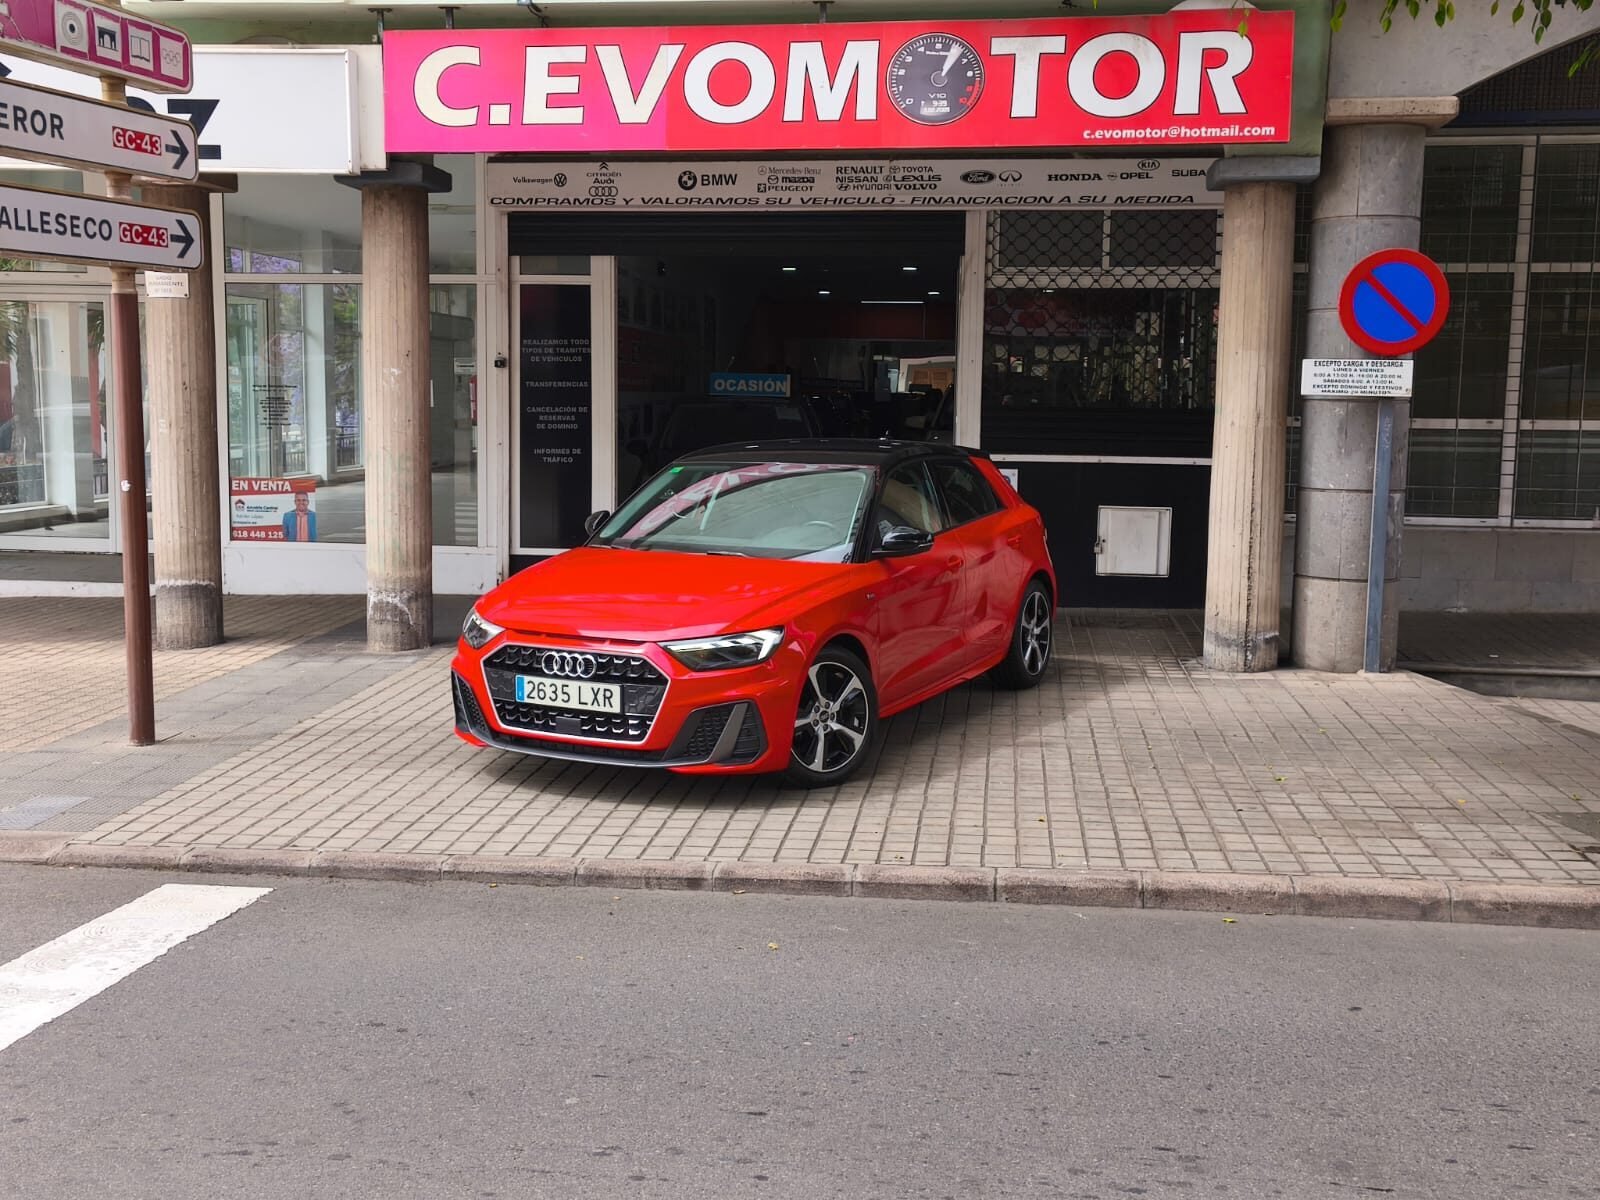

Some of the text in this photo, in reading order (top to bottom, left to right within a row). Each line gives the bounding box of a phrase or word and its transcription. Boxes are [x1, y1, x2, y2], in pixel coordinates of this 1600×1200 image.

[1083, 124, 1276, 139] c.evomotor@hotmail.com
[112, 127, 162, 155] GC-43
[1141, 160, 1157, 168] KIA
[835, 165, 885, 175] RENAULT
[701, 174, 738, 186] BMW
[835, 175, 879, 183] NISSAN
[892, 174, 943, 182] LEXUS
[1047, 174, 1102, 182] HONDA
[1120, 171, 1153, 180] OPEL
[513, 176, 553, 185] Volkswagen
[592, 177, 615, 185] Audi
[852, 183, 892, 191] HYUNDAI
[490, 197, 617, 206] COMPRAMOS
[622, 197, 636, 206] Y
[640, 197, 760, 205] VALORAMOS
[764, 197, 792, 205] SU
[799, 196, 896, 205] VEHICULO
[910, 196, 1054, 205] FINANCIACION
[1058, 196, 1072, 204] A
[1077, 195, 1107, 204] SU
[1113, 195, 1195, 204] MEDIDA
[0, 206, 168, 247] ALLESECO GC-43
[1343, 360, 1364, 368] CARGA
[714, 377, 786, 393] OCASIÓN
[232, 480, 292, 492] EN VENTA
[526, 680, 614, 708] 2635 LXR
